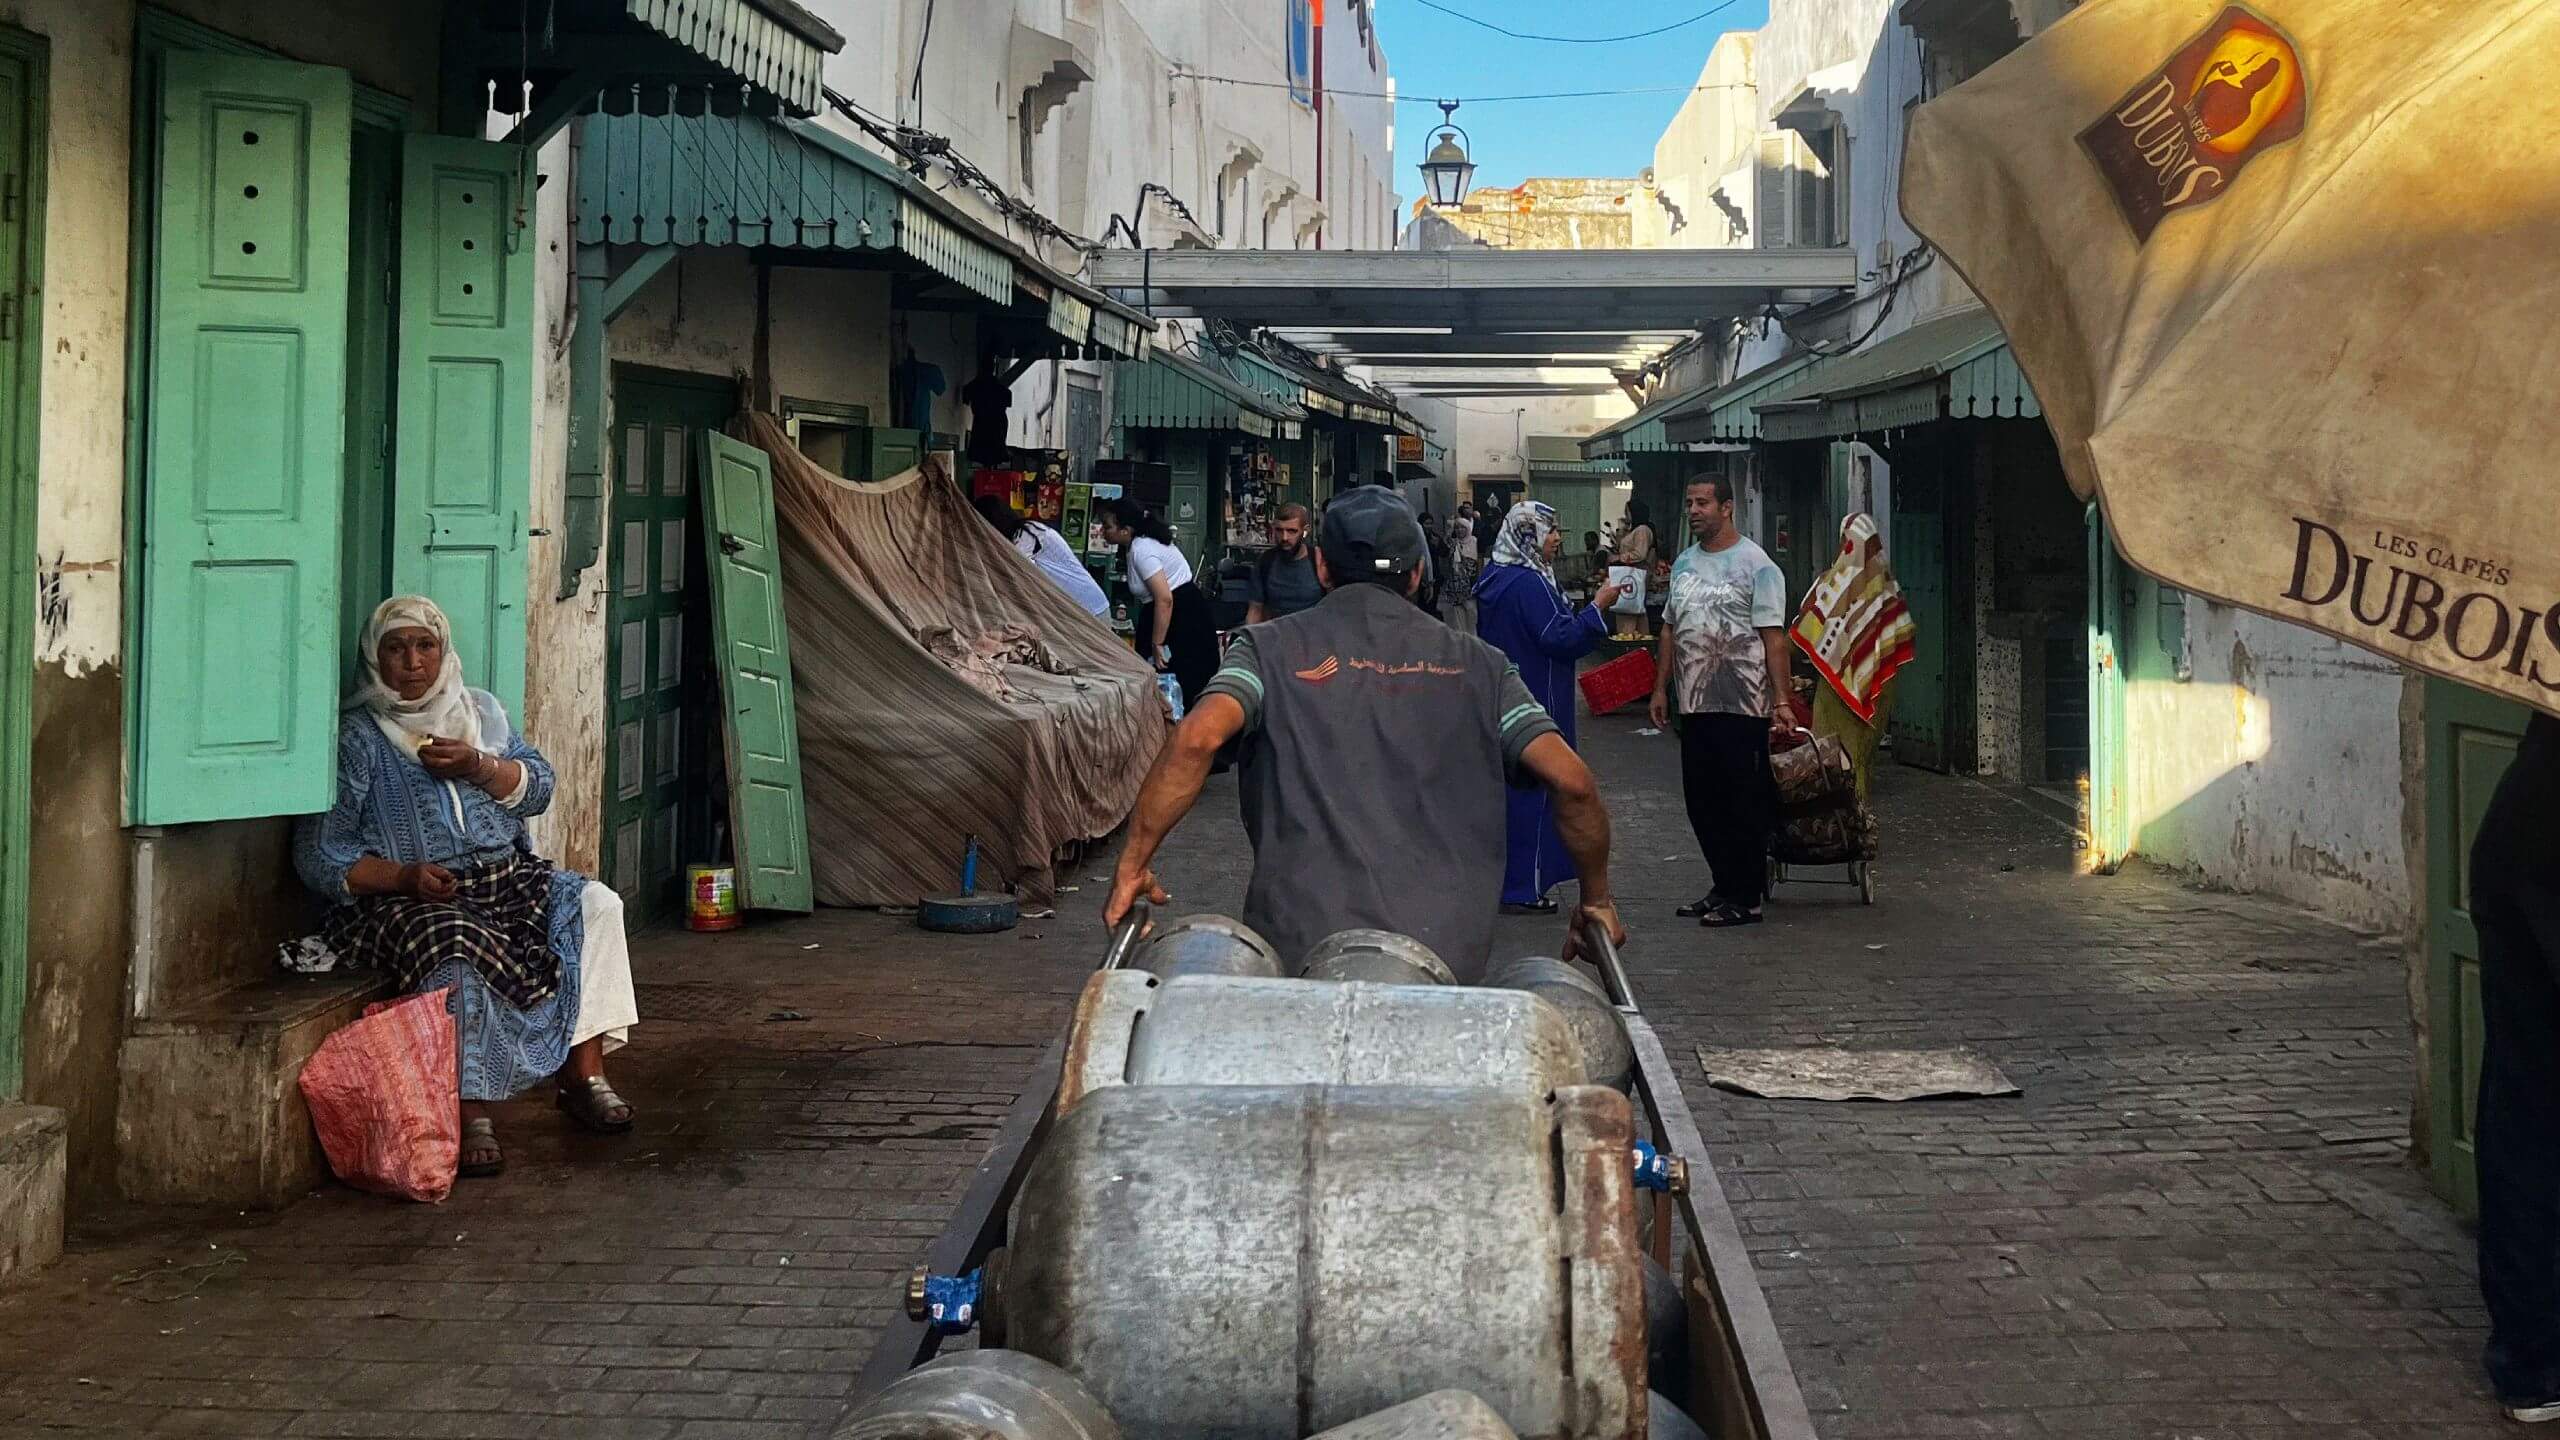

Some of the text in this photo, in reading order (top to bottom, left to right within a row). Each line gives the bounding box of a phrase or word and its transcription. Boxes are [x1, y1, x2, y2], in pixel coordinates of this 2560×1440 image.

[2116, 74, 2224, 207] DUBOIS
[2280, 516, 2560, 692] DUBOIS
[2373, 531, 2511, 586] LES CAFÉS
